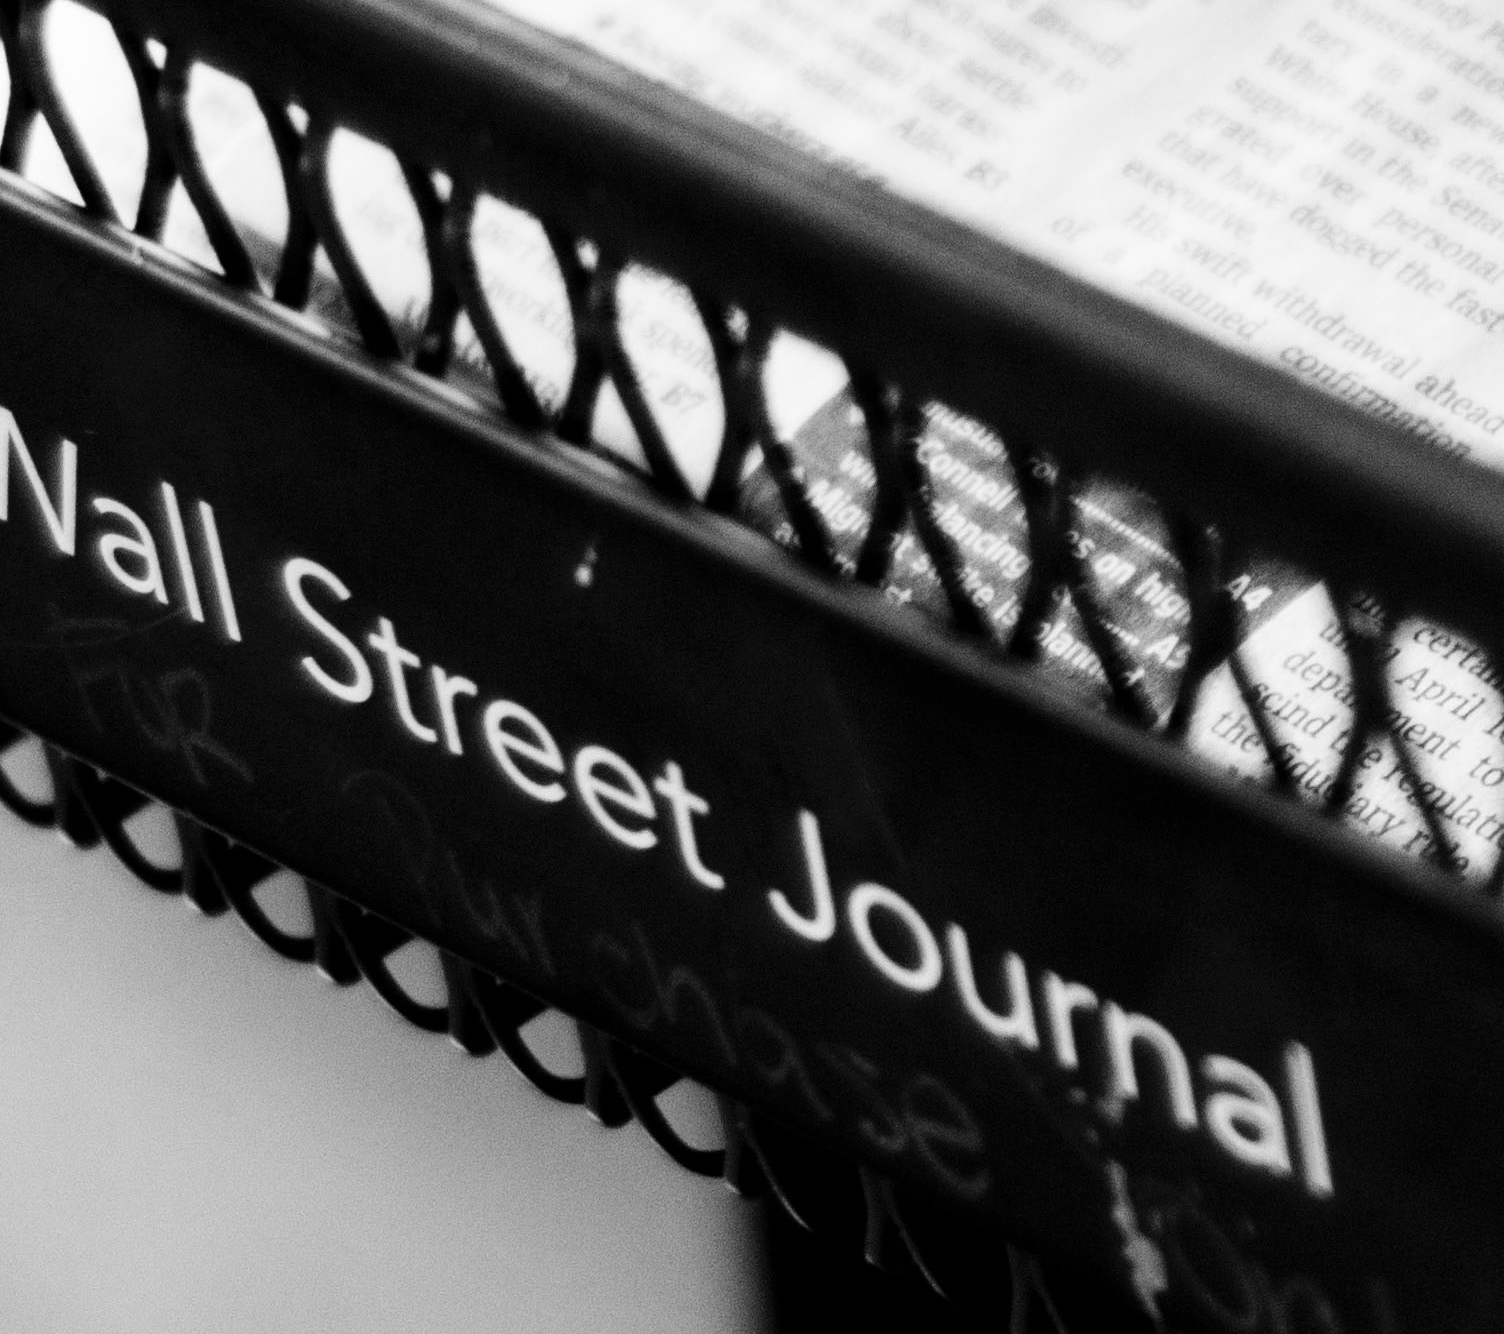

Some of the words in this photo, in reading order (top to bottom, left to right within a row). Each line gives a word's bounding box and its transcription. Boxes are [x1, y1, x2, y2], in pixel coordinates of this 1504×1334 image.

[1252, 679, 1337, 739] scind
[1397, 667, 1486, 722] April
[1209, 709, 1264, 755] the
[282, 557, 726, 890] Street
[766, 809, 1335, 1198] Journal
